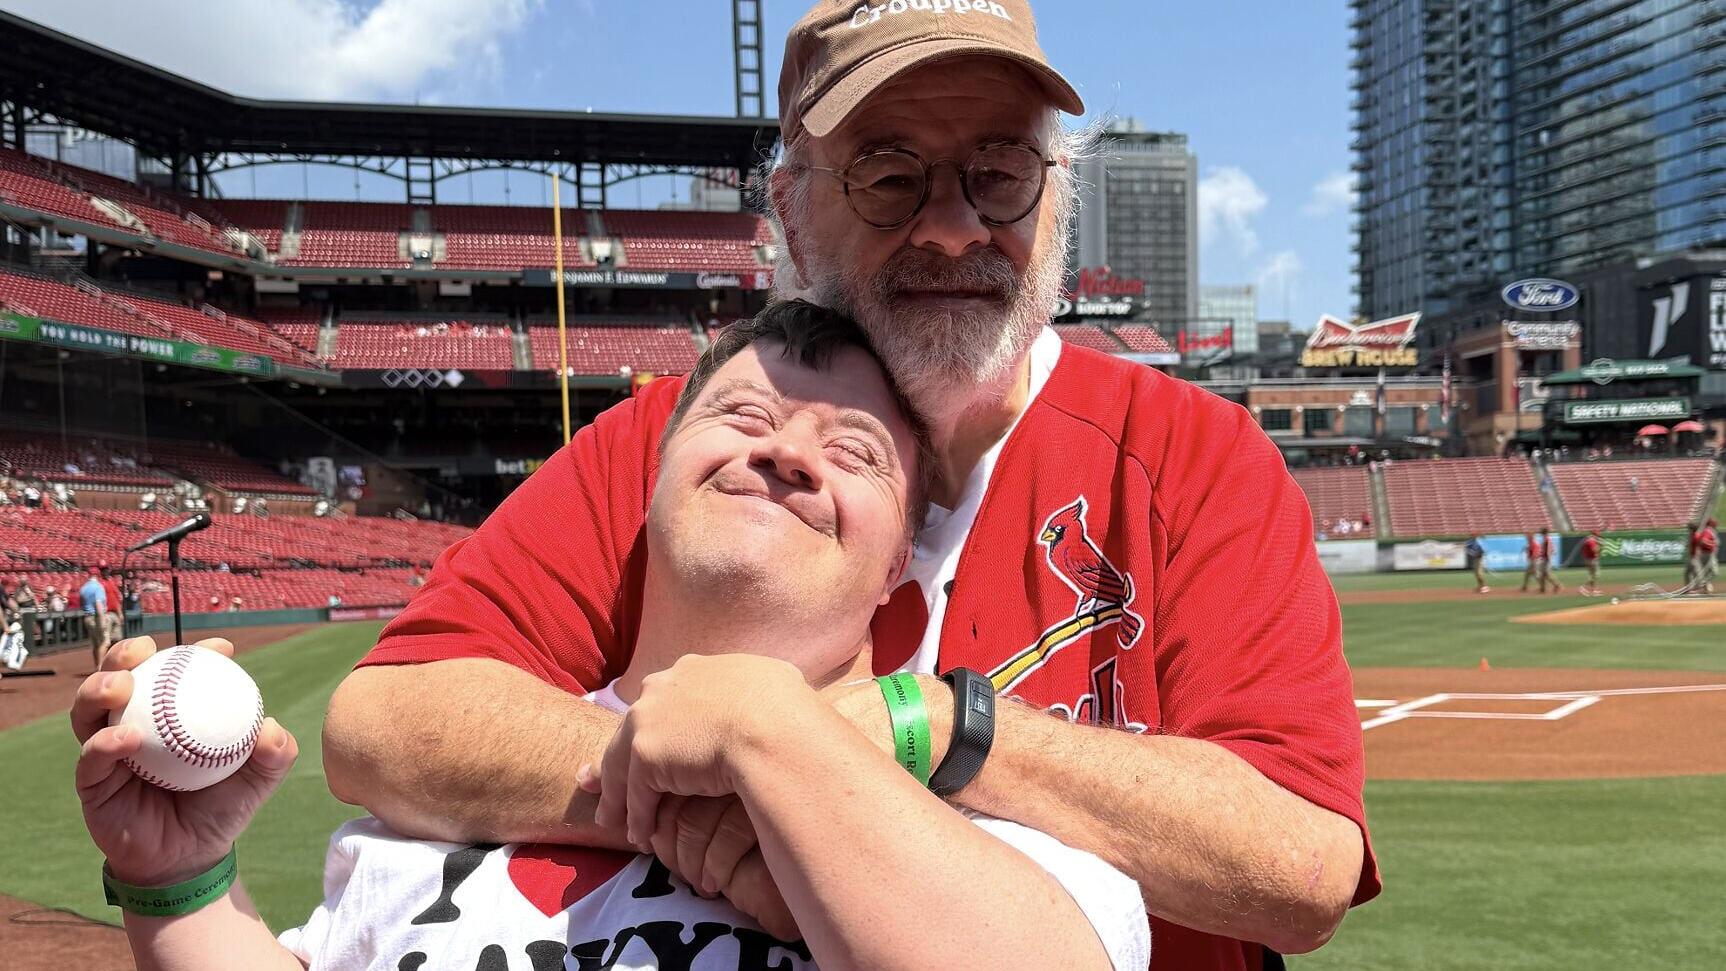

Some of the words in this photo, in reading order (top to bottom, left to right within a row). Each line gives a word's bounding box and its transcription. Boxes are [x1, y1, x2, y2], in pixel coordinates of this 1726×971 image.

[850, 0, 1012, 28] Crouppen
[550, 270, 604, 285] BNJAMIN
[1518, 283, 1565, 306] Ford
[41, 324, 66, 340] YOU
[70, 330, 101, 345] HOLD
[106, 336, 127, 349] THE
[130, 337, 174, 357] POWER
[1301, 349, 1354, 367] BREW
[1356, 349, 1418, 367] HOUSE
[1572, 403, 1618, 419] SAFETY
[1620, 401, 1682, 416] NATIONAL
[496, 459, 544, 474] bet3
[1620, 539, 1686, 556] National
[128, 895, 192, 908] Pre-Game
